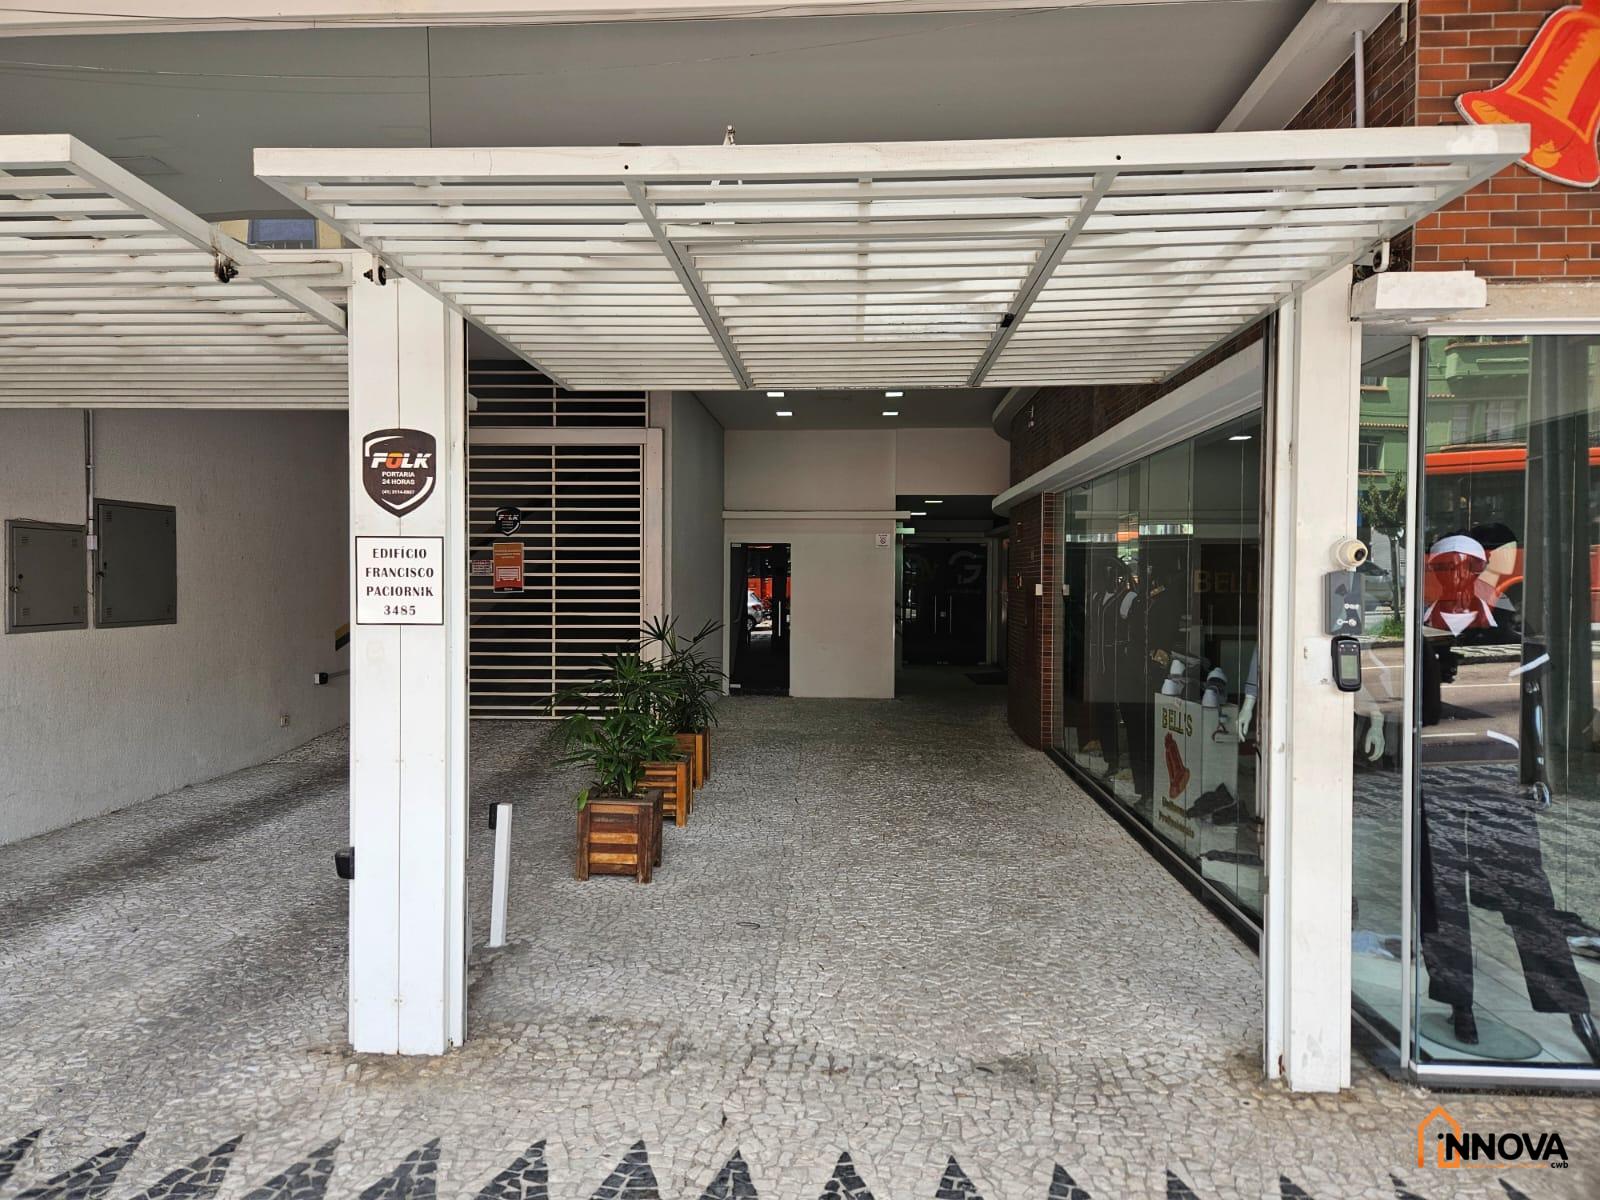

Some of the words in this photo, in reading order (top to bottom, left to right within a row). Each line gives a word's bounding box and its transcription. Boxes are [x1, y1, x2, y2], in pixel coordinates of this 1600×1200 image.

[371, 452, 433, 469] FOLK
[391, 478, 415, 486] HORAS
[372, 545, 427, 559] EDIFÍCIO
[365, 567, 434, 578] FRANCISCO
[366, 585, 434, 597] PACIORNIK
[384, 604, 416, 616] 3485
